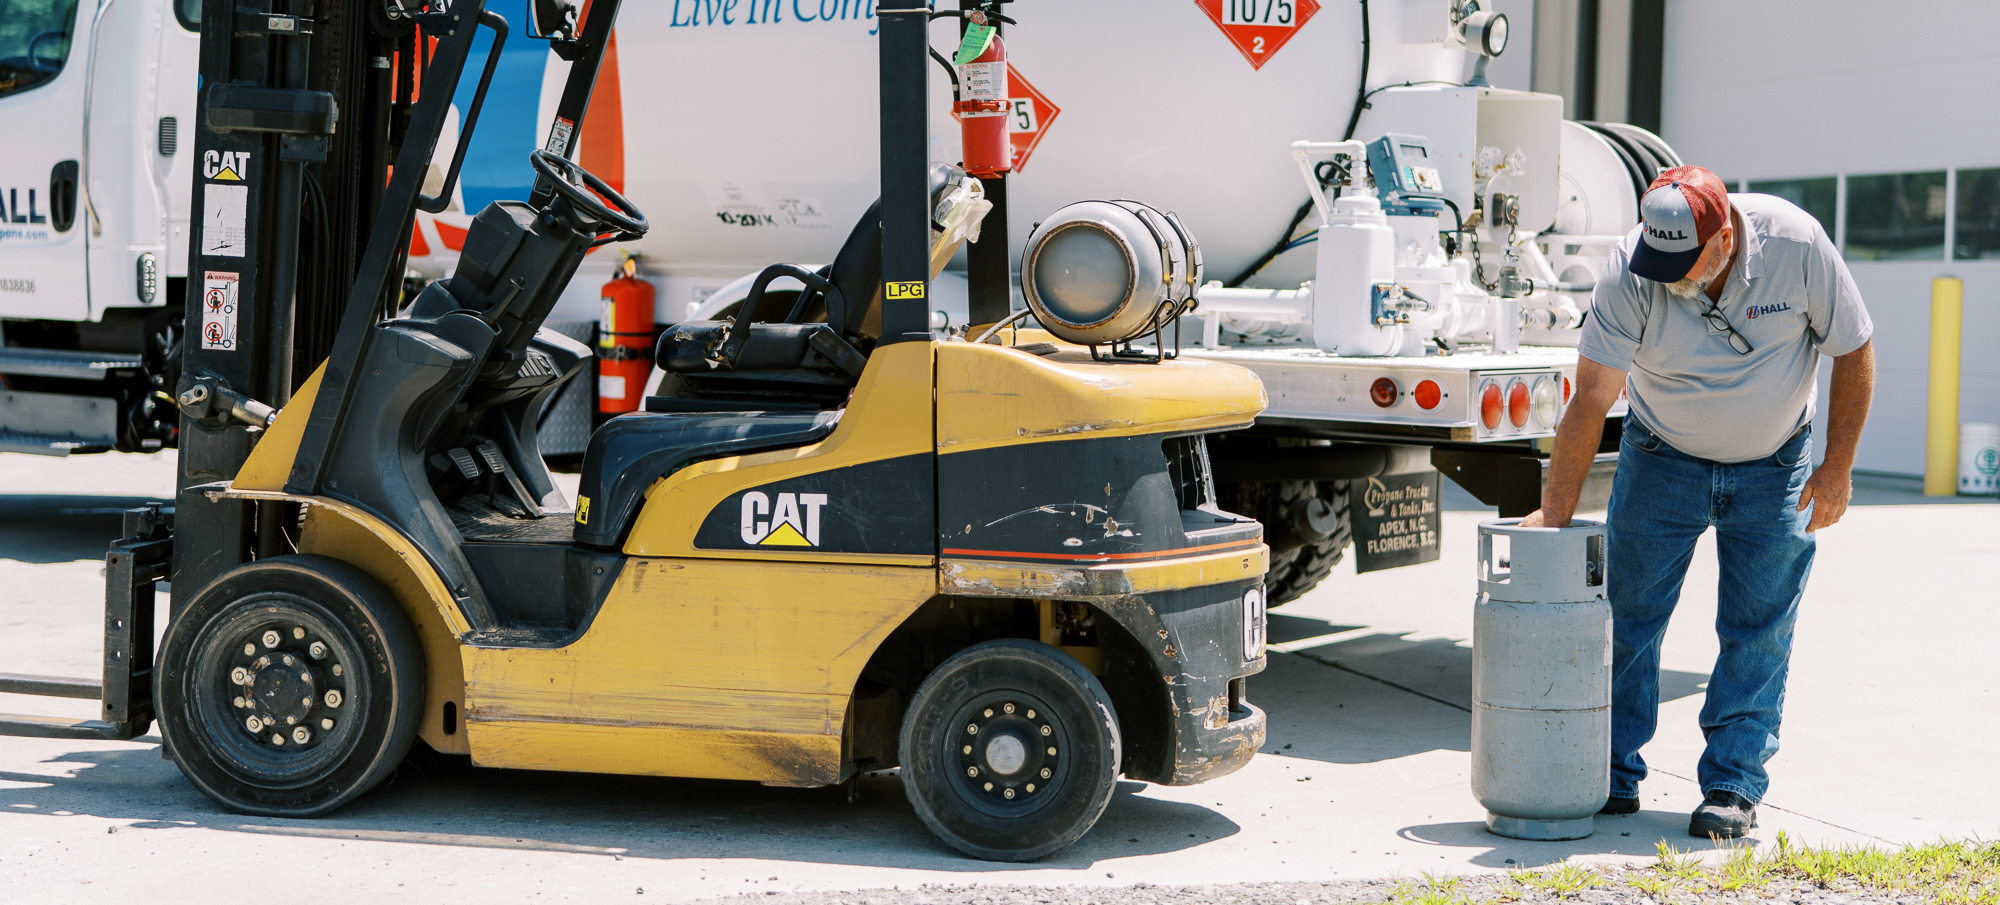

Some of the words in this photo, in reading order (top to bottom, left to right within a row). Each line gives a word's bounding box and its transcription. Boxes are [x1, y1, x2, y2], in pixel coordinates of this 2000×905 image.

[669, 0, 738, 27] Live
[746, 0, 782, 24] In
[793, 0, 879, 36] Com
[1230, 0, 1292, 24] 1075
[1252, 36, 1265, 54] 2
[203, 150, 250, 180] CAT
[1648, 225, 1688, 240] HALL
[888, 284, 922, 297] LPG
[1760, 302, 1791, 315] HALL
[1371, 489, 1404, 504] Propane
[1405, 484, 1430, 500] Trucks
[741, 491, 828, 547] CAT
[1391, 503, 1397, 518] &
